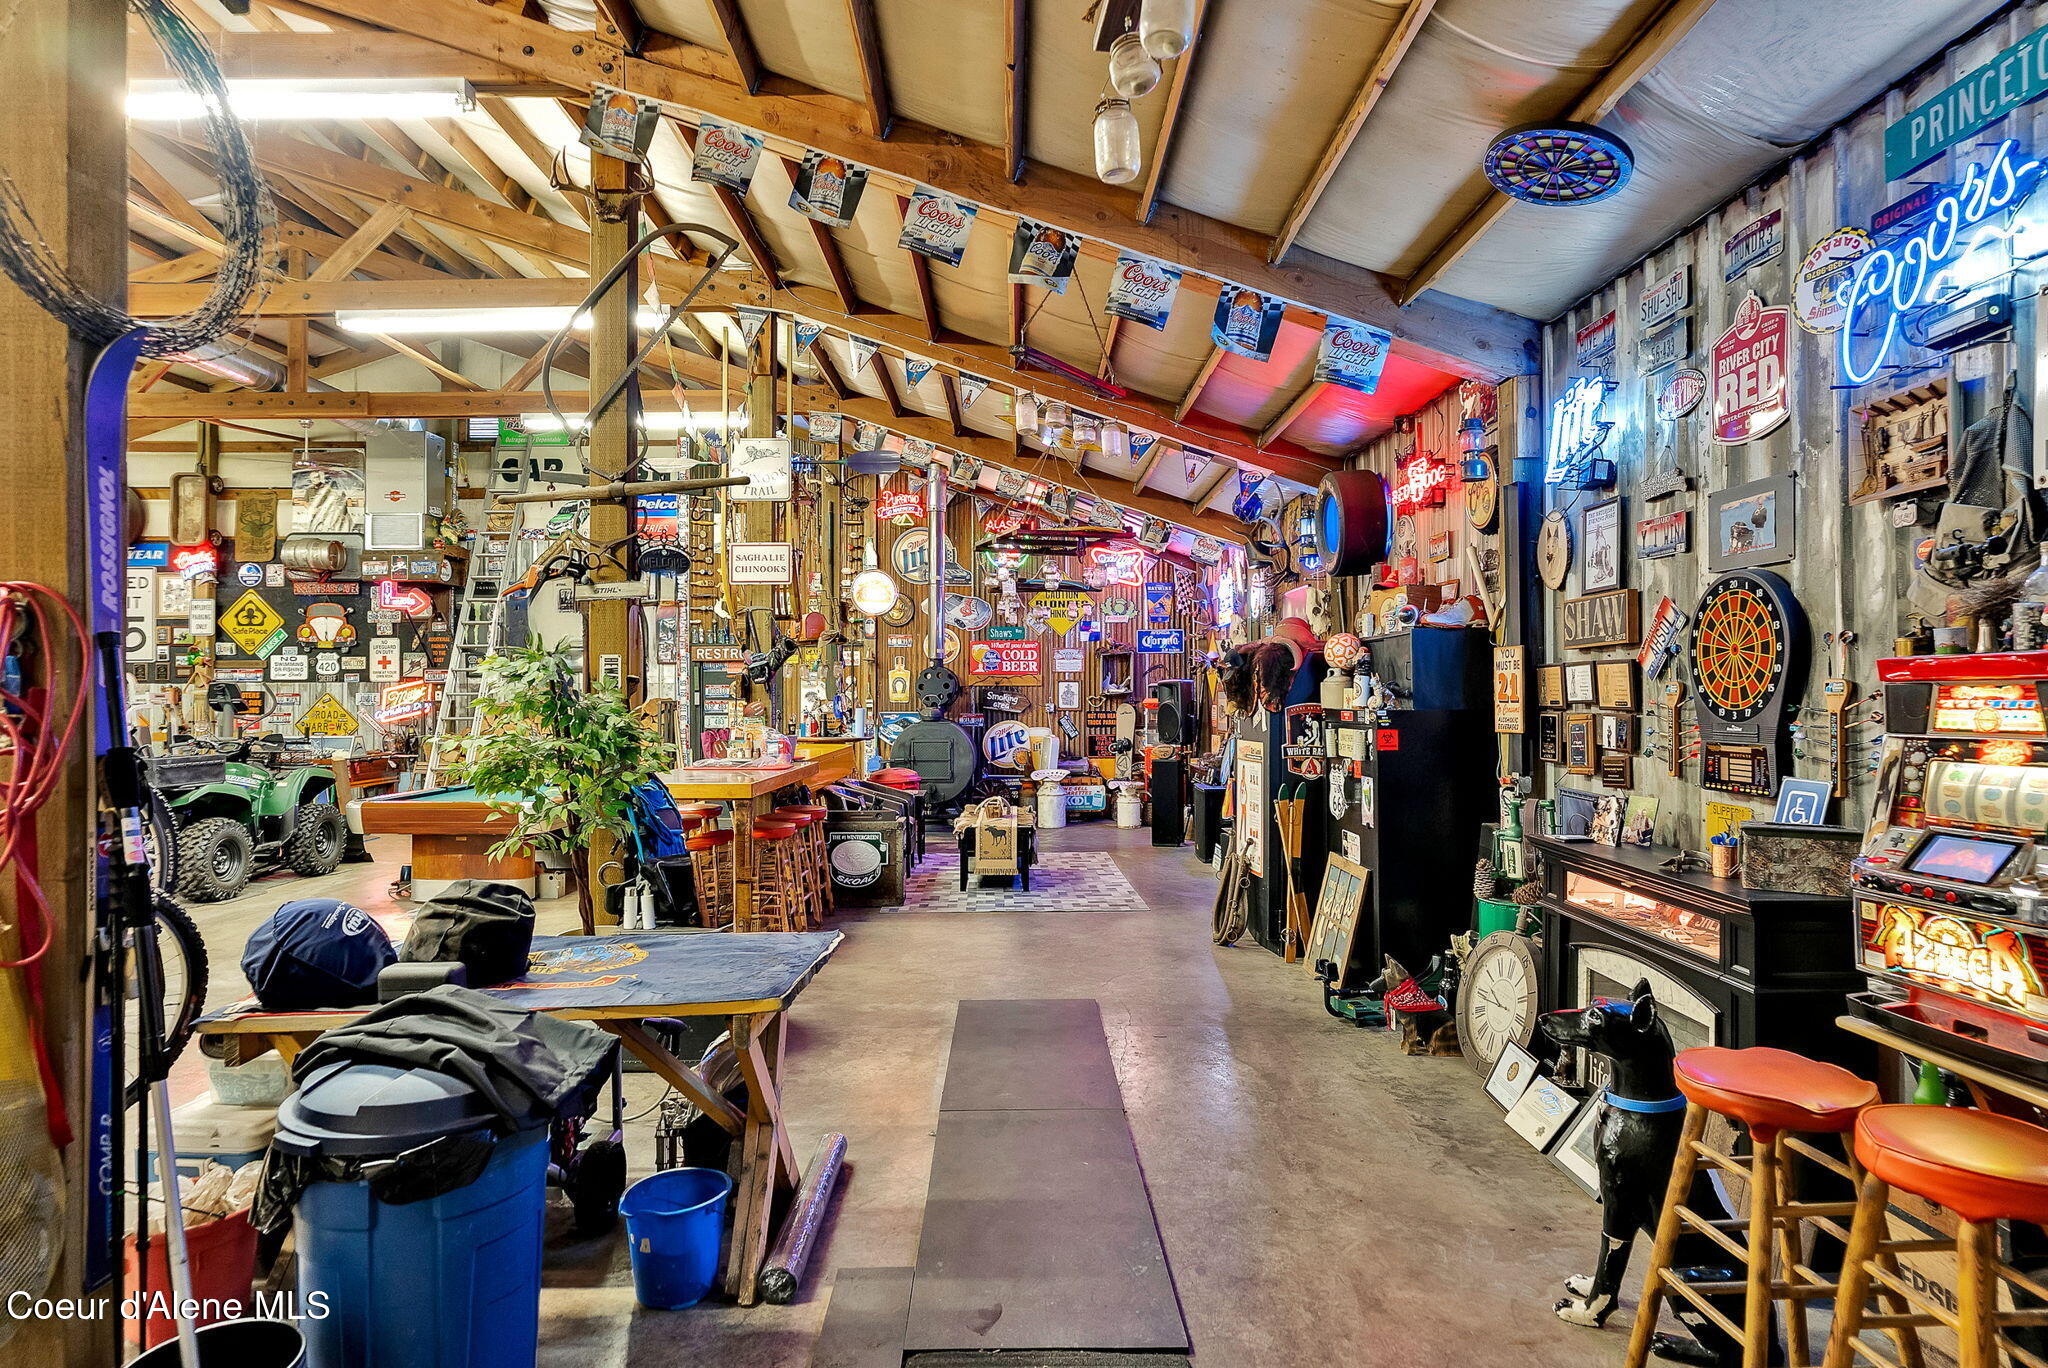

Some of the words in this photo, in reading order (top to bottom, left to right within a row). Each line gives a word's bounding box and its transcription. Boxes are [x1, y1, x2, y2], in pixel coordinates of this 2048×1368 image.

[705, 129, 752, 159] Coors
[700, 146, 747, 167] LIGHT
[813, 177, 842, 193] Coors
[812, 188, 840, 199] LIGHT
[918, 199, 965, 229] Coors
[1874, 196, 1928, 229] ORIGINAL
[914, 215, 961, 238] LIGHT
[1029, 241, 1059, 266] Coors
[1806, 235, 1861, 269] GARAGE
[1836, 139, 2015, 382] Coors
[1123, 264, 1171, 293] Coors
[1119, 279, 1165, 302] LIGHT
[1641, 279, 1684, 322] SHU-SHU
[1231, 307, 1257, 326] Coors
[1229, 320, 1255, 332] LIGHT
[1331, 330, 1380, 358] Coors
[1328, 347, 1376, 367] LIGHT
[1719, 347, 1750, 377] RIVER
[1752, 333, 1780, 361] CITY
[909, 361, 929, 371] Lite
[1719, 354, 1780, 417] RED
[1131, 434, 1153, 444] Lite
[743, 485, 778, 496] TRAIL
[637, 499, 678, 510] Delco
[98, 466, 118, 613] ROSSIGNOL
[642, 557, 688, 569] WELCOME
[735, 554, 786, 562] SAGHALIE
[734, 565, 787, 574] CHINOOKS
[1729, 580, 1738, 588] 20
[1718, 586, 1723, 594] 5
[1756, 588, 1763, 598] 18
[1706, 596, 1713, 604] 12
[1767, 603, 1773, 612] 4
[1564, 595, 1626, 641] SHAW
[1698, 611, 1704, 620] 9
[1773, 621, 1780, 630] 13
[1776, 642, 1783, 651] 6
[1002, 650, 1038, 660] COLD
[1500, 649, 1516, 658] YOU
[1691, 649, 1696, 657] 11
[319, 663, 336, 672] 420
[1001, 661, 1038, 672] BEER
[1496, 660, 1512, 671] MUST
[1513, 659, 1520, 670] BE
[1774, 664, 1782, 673] 10
[1693, 668, 1698, 676] 8
[1498, 673, 1520, 703] 21
[1698, 685, 1705, 693] 16
[1767, 683, 1775, 692] 15
[987, 692, 1019, 703] Smoking
[993, 702, 1010, 710] area
[1758, 700, 1763, 708] 2
[315, 711, 338, 720] ROAD
[1718, 708, 1726, 716] 19
[1732, 711, 1737, 720] 3
[1745, 709, 1752, 717] 17
[988, 728, 1027, 761] Lite
[1286, 747, 1311, 756] WHITE
[1065, 796, 1091, 806] KOOL
[1332, 796, 1342, 813] 66
[836, 874, 875, 885] SKOAL
[1893, 928, 2028, 1008] AZTECA
